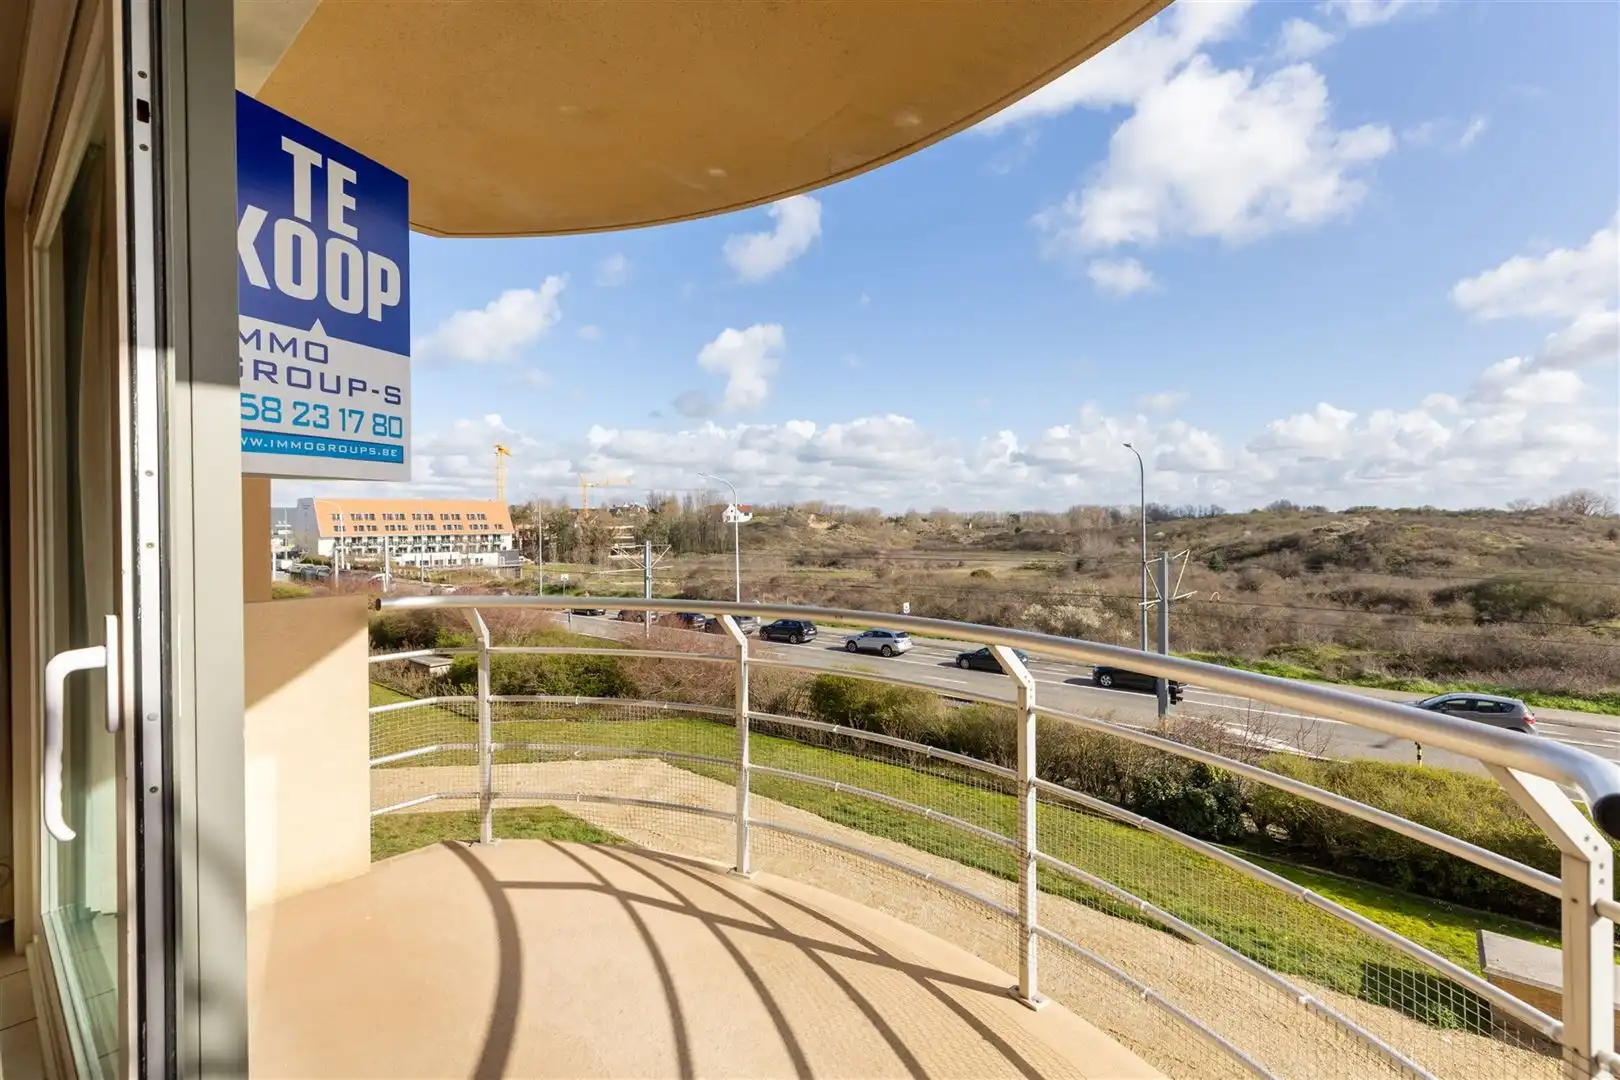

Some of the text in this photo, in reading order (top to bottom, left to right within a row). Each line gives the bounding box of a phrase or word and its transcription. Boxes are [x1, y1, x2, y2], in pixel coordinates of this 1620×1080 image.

[281, 135, 358, 241] TE
[237, 204, 400, 322] KOOP
[239, 357, 401, 406] ROUP-S
[292, 400, 330, 430] 23
[338, 408, 364, 434] 17
[372, 413, 402, 439] 80
